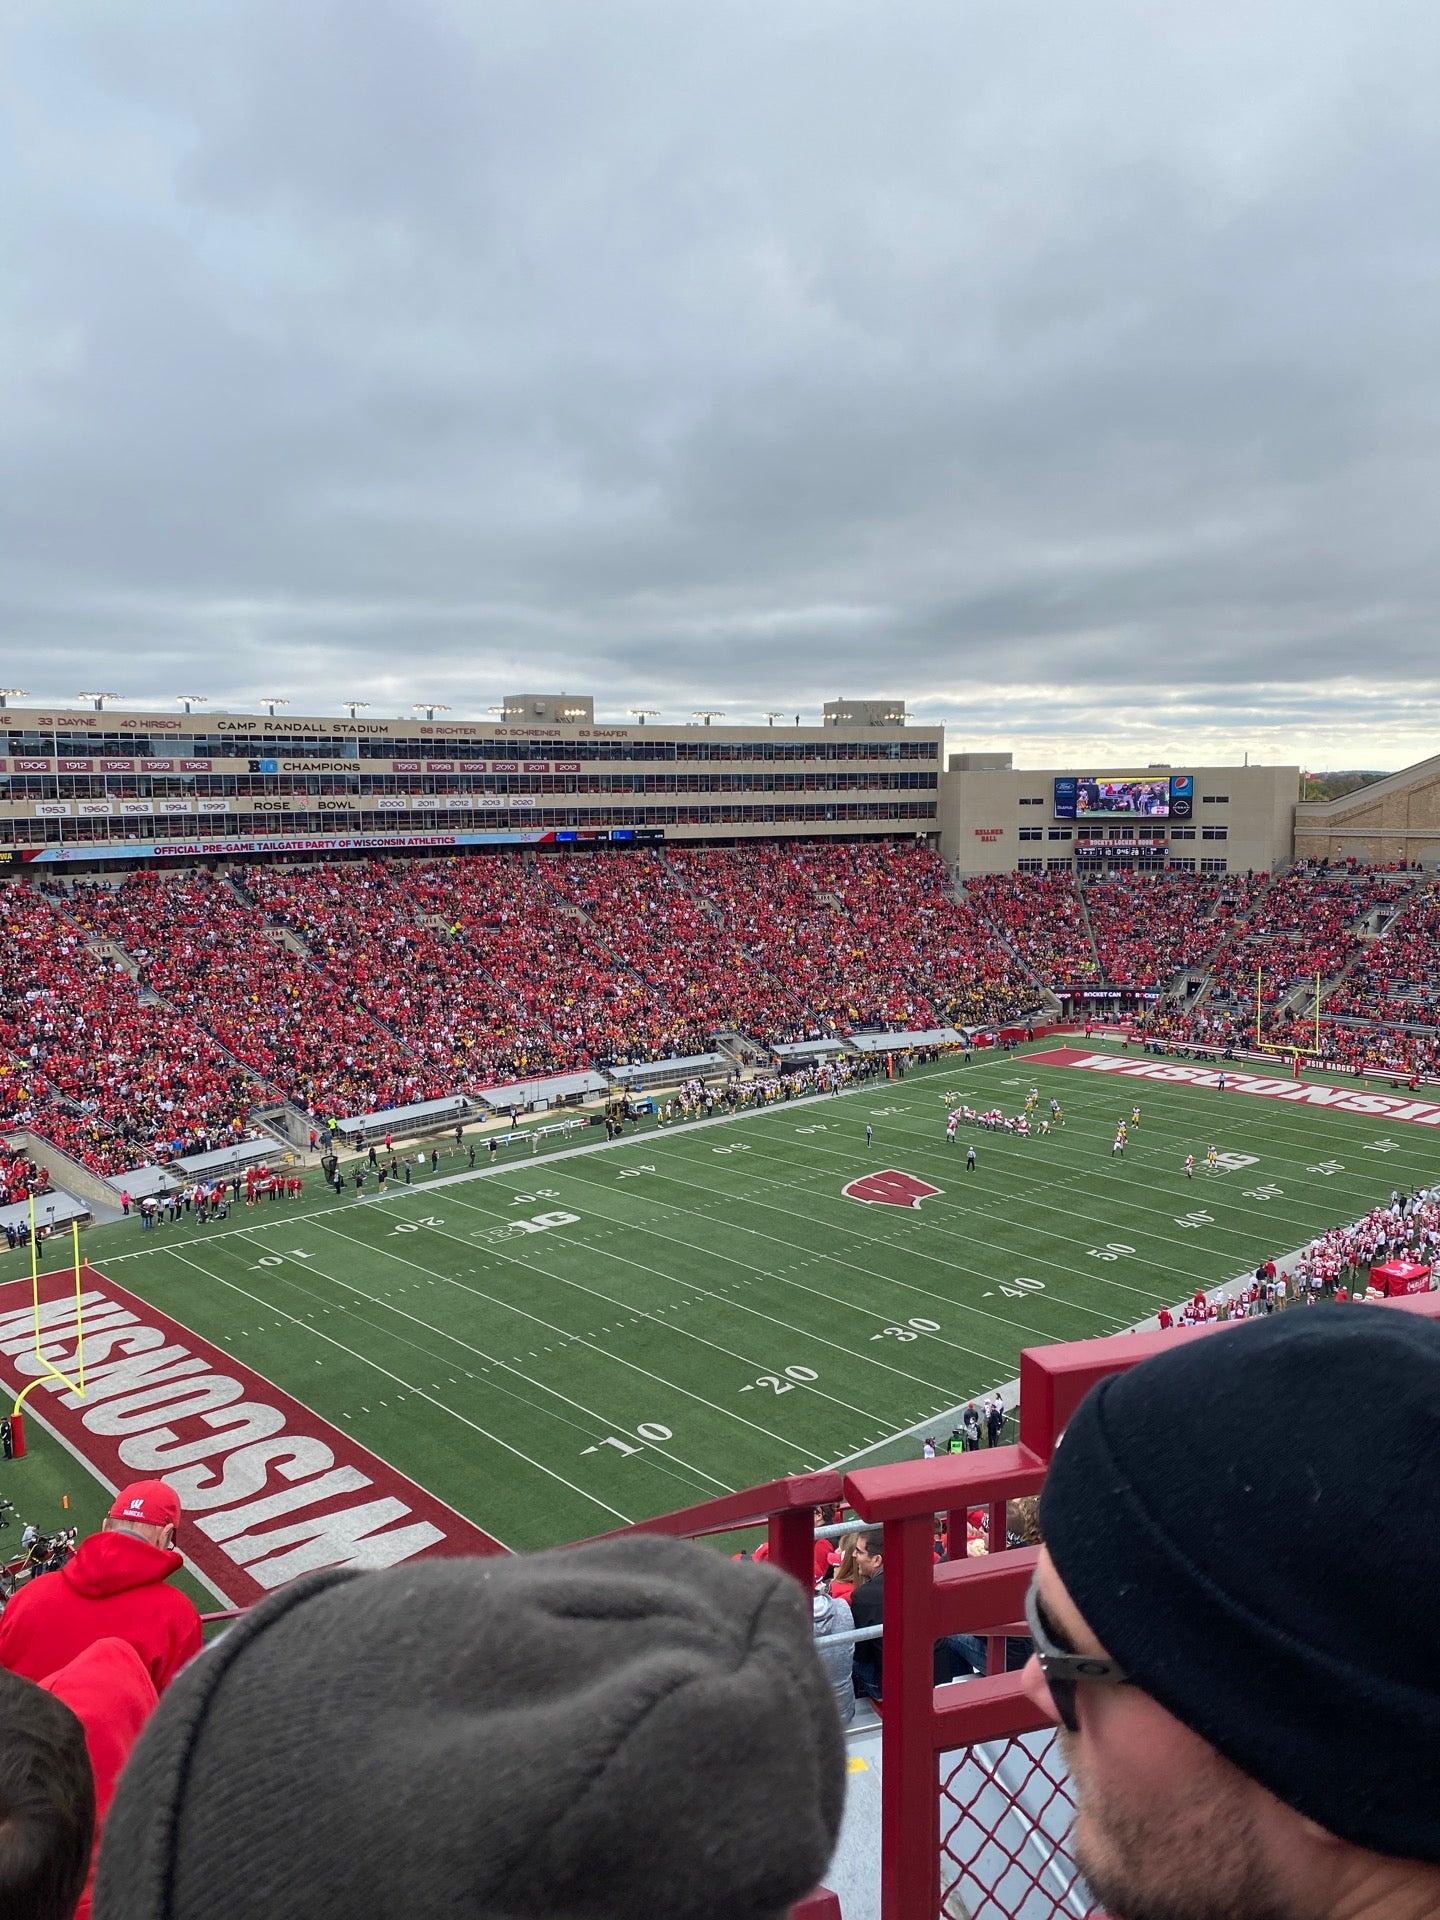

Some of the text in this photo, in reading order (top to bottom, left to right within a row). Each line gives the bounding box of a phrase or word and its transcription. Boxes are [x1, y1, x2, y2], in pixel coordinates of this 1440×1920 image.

[38, 717, 97, 726] 33 DAYNE
[121, 720, 182, 729] 40 HIRSCH
[217, 721, 389, 733] CAMP RANDALL STADIUM
[436, 727, 476, 735] RICHTER
[509, 729, 561, 737] SCHREINER
[283, 762, 361, 771] CHAMPIONS
[397, 763, 418, 771] 1993
[125, 804, 149, 812] 1963
[203, 803, 226, 811] 1999
[254, 801, 355, 811] ROSE BOWL
[379, 800, 405, 808] 2000
[41, 806, 66, 814] 1953
[83, 805, 109, 813] 1960
[154, 836, 456, 855] OFFICIAL PRE-GAME TAILGATE PARTY OF WISCONSIN ATHLETICS
[1284, 1056, 1360, 1073] WINSIN BADGER
[1069, 1055, 1440, 1125] WISCONSI
[1087, 1242, 1137, 1261] 50
[999, 1276, 1047, 1299] 40
[883, 1317, 941, 1342] 30
[755, 1364, 819, 1395] 20
[597, 1422, 674, 1458] 10
